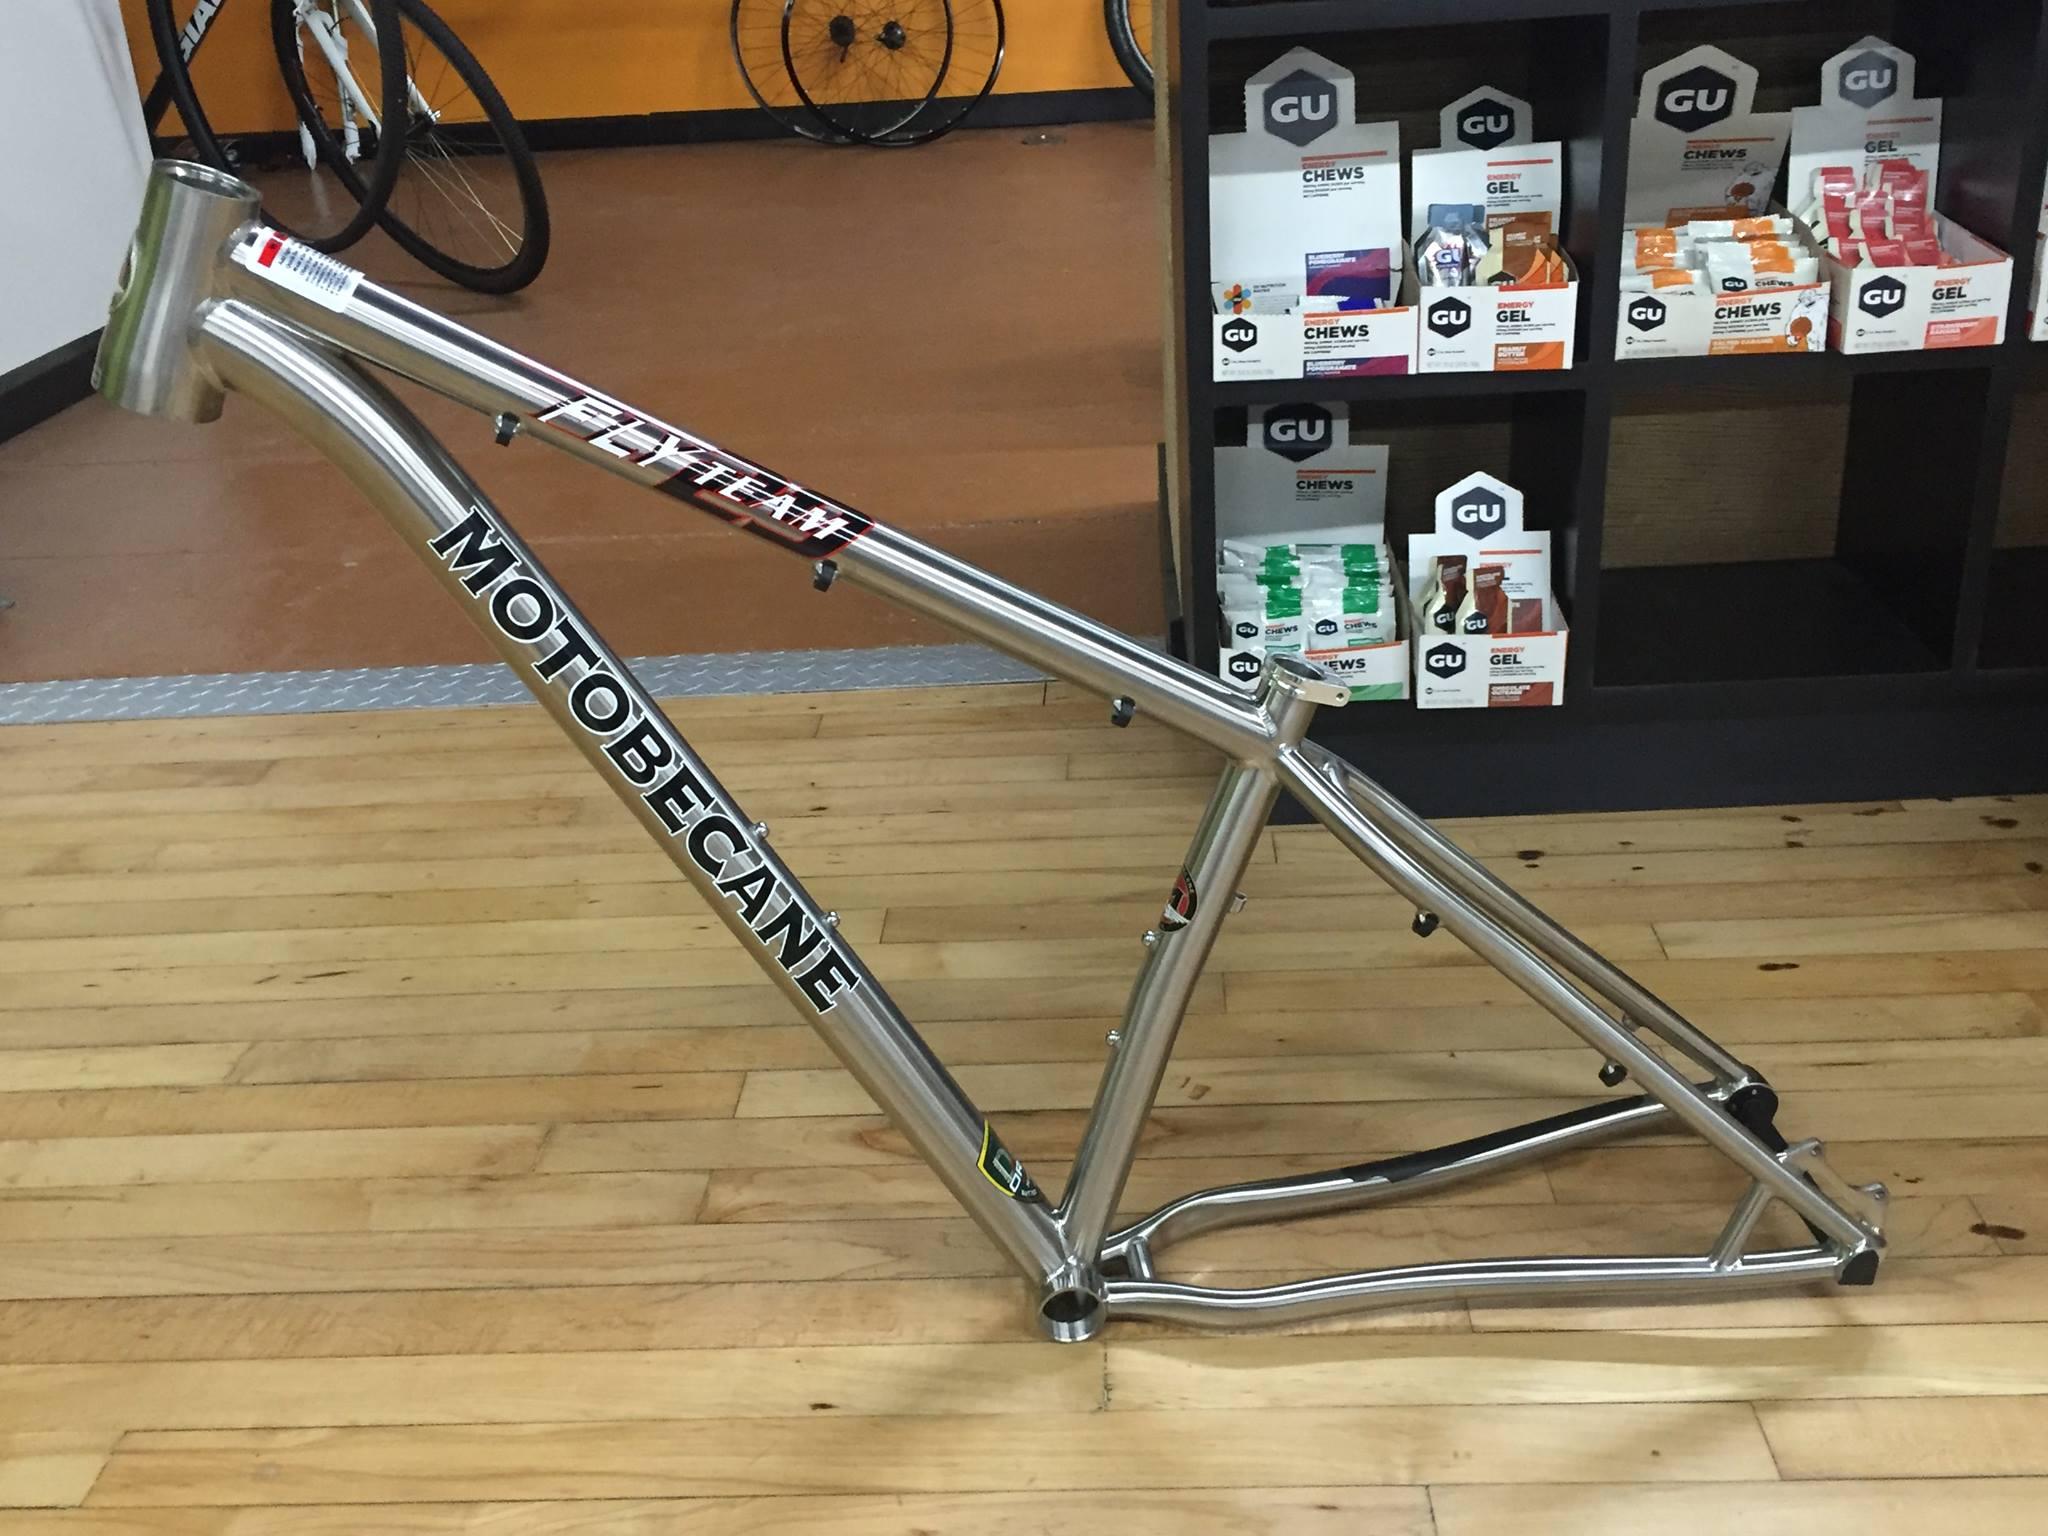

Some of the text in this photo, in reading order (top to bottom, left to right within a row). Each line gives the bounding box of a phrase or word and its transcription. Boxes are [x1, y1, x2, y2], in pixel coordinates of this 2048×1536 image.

[1845, 69, 1891, 91] GU
[1664, 88, 1728, 113] GU
[1271, 94, 1330, 123] GU
[1463, 114, 1509, 134] GU
[1864, 140, 1897, 153] GEL
[1683, 148, 1748, 160] CHEWS
[1302, 166, 1364, 182] CHEWS
[1486, 181, 1519, 194] GEL
[1934, 277, 1972, 287] ENERGY
[1863, 289, 1901, 305] GU
[1932, 287, 1967, 301] GEL
[1497, 301, 1535, 309] ENERGY
[1714, 302, 1782, 320] CHEWS
[1431, 310, 1467, 325] GU
[1496, 310, 1531, 323] GEL
[1631, 307, 1663, 321] GU
[1304, 319, 1340, 327] ENERGY
[1224, 329, 1254, 341] GU
[1304, 325, 1369, 340] CHEWS
[1270, 418, 1325, 441] GU
[537, 394, 851, 541] FLY TEAM
[1296, 480, 1353, 490] CHEWS
[1456, 504, 1500, 523] GU
[1436, 613, 1455, 624] GU
[1466, 619, 1488, 630] GU
[1238, 627, 1257, 635] GU
[1265, 625, 1298, 635] CHEWS
[1317, 624, 1335, 634] GU
[1429, 654, 1462, 668] GU
[1490, 654, 1522, 665] GEL
[1231, 661, 1259, 673] GU
[427, 506, 860, 1014] MOTOBECANE
